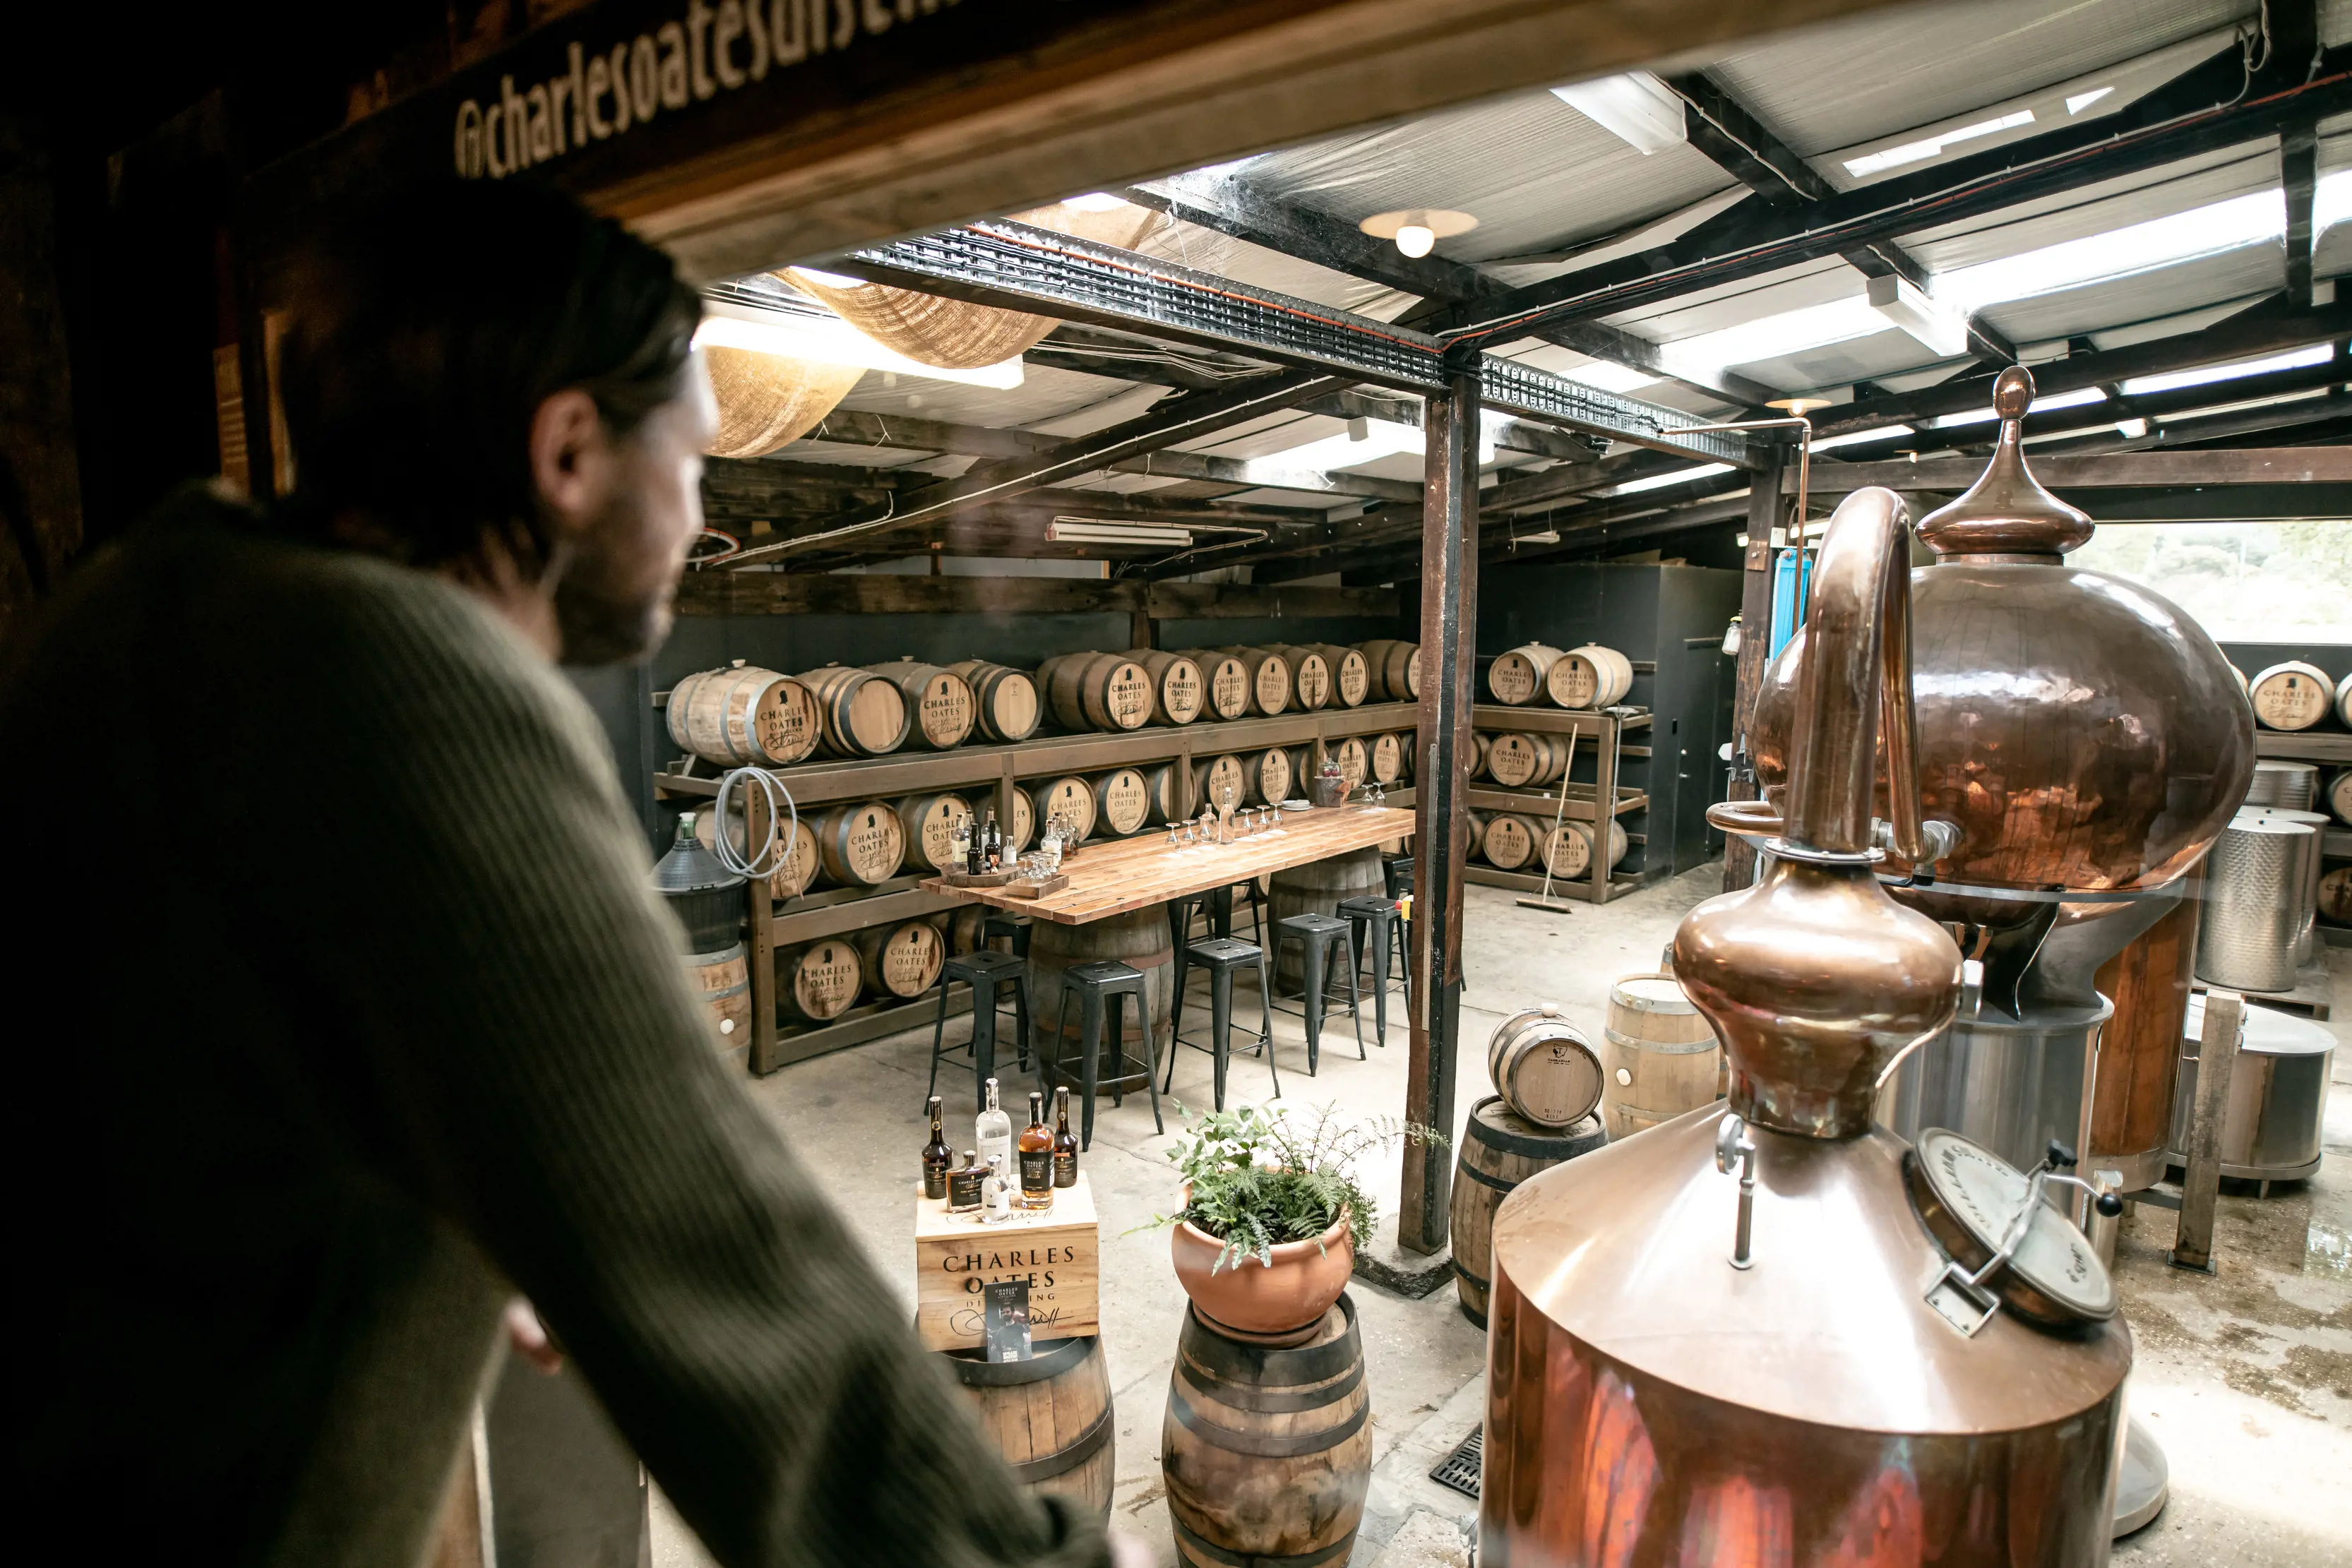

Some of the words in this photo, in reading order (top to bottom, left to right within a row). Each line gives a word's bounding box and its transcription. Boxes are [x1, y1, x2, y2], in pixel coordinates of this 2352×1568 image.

[1342, 669, 1363, 677] CHARLES
[1498, 669, 1532, 678] CHARLES
[1112, 682, 1145, 692] CHARLES
[1167, 681, 1197, 689] CHARLES
[1118, 692, 1141, 700] OATES
[924, 696, 965, 710] CHARLES
[760, 707, 803, 721] CHARLE
[932, 707, 960, 718] OATES
[770, 717, 803, 731] OATES
[1496, 749, 1530, 760] CHARLES
[1501, 756, 1524, 766] OATES
[1211, 771, 1238, 784] CHARLES
[1216, 780, 1235, 791] OATES
[1109, 790, 1141, 798] CHARLES
[1051, 798, 1087, 811] CHARLES
[1114, 798, 1136, 807] OATES
[926, 820, 958, 832] CHARL
[852, 827, 893, 845] CHARLES
[933, 830, 953, 841] OAT
[1491, 832, 1524, 842] CHARLES
[859, 838, 888, 854] OATES
[1496, 839, 1520, 848] OATES
[810, 976, 844, 988] OATES
[943, 1246, 1073, 1272] CHARLES
